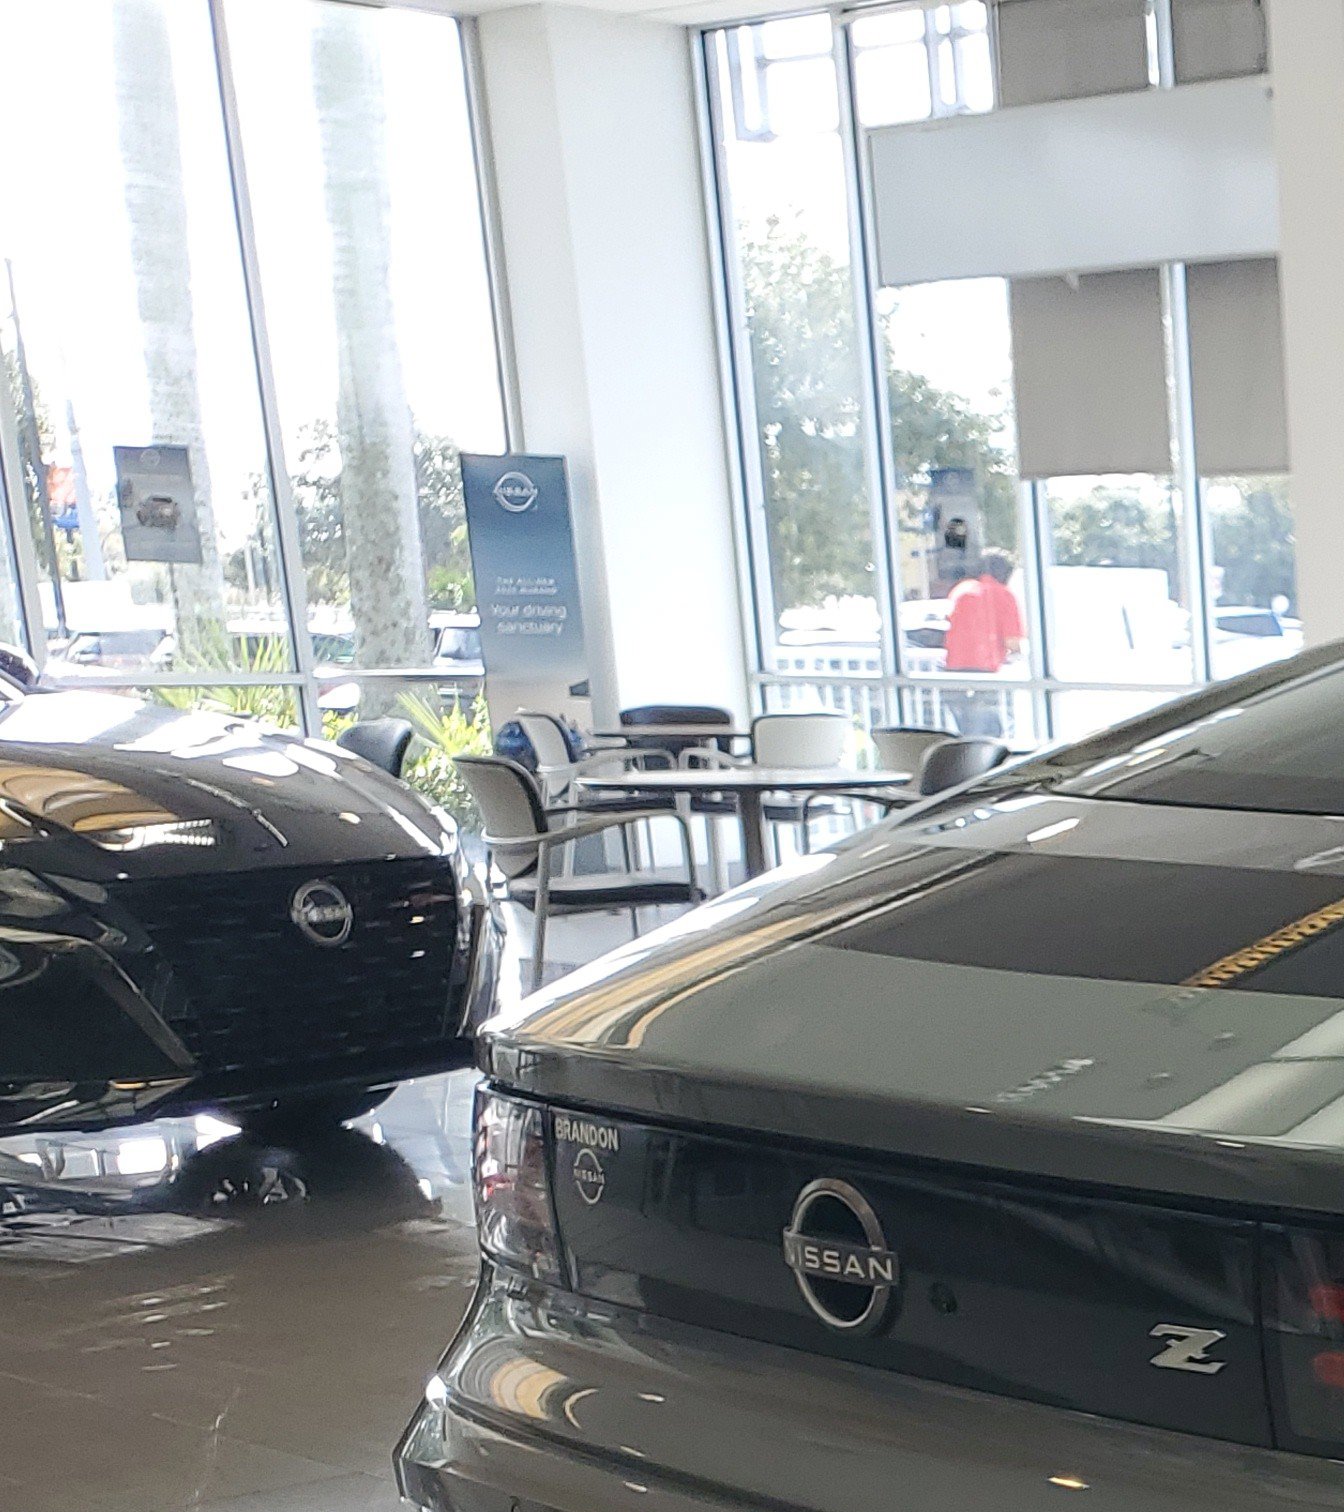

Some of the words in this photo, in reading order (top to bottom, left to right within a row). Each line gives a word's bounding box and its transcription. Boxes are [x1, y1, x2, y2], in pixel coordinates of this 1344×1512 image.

[491, 604, 520, 616] Your
[522, 603, 567, 619] driving
[497, 621, 563, 635] sanctuary
[554, 1116, 619, 1152] BRANDON
[1148, 1323, 1228, 1375] Z
